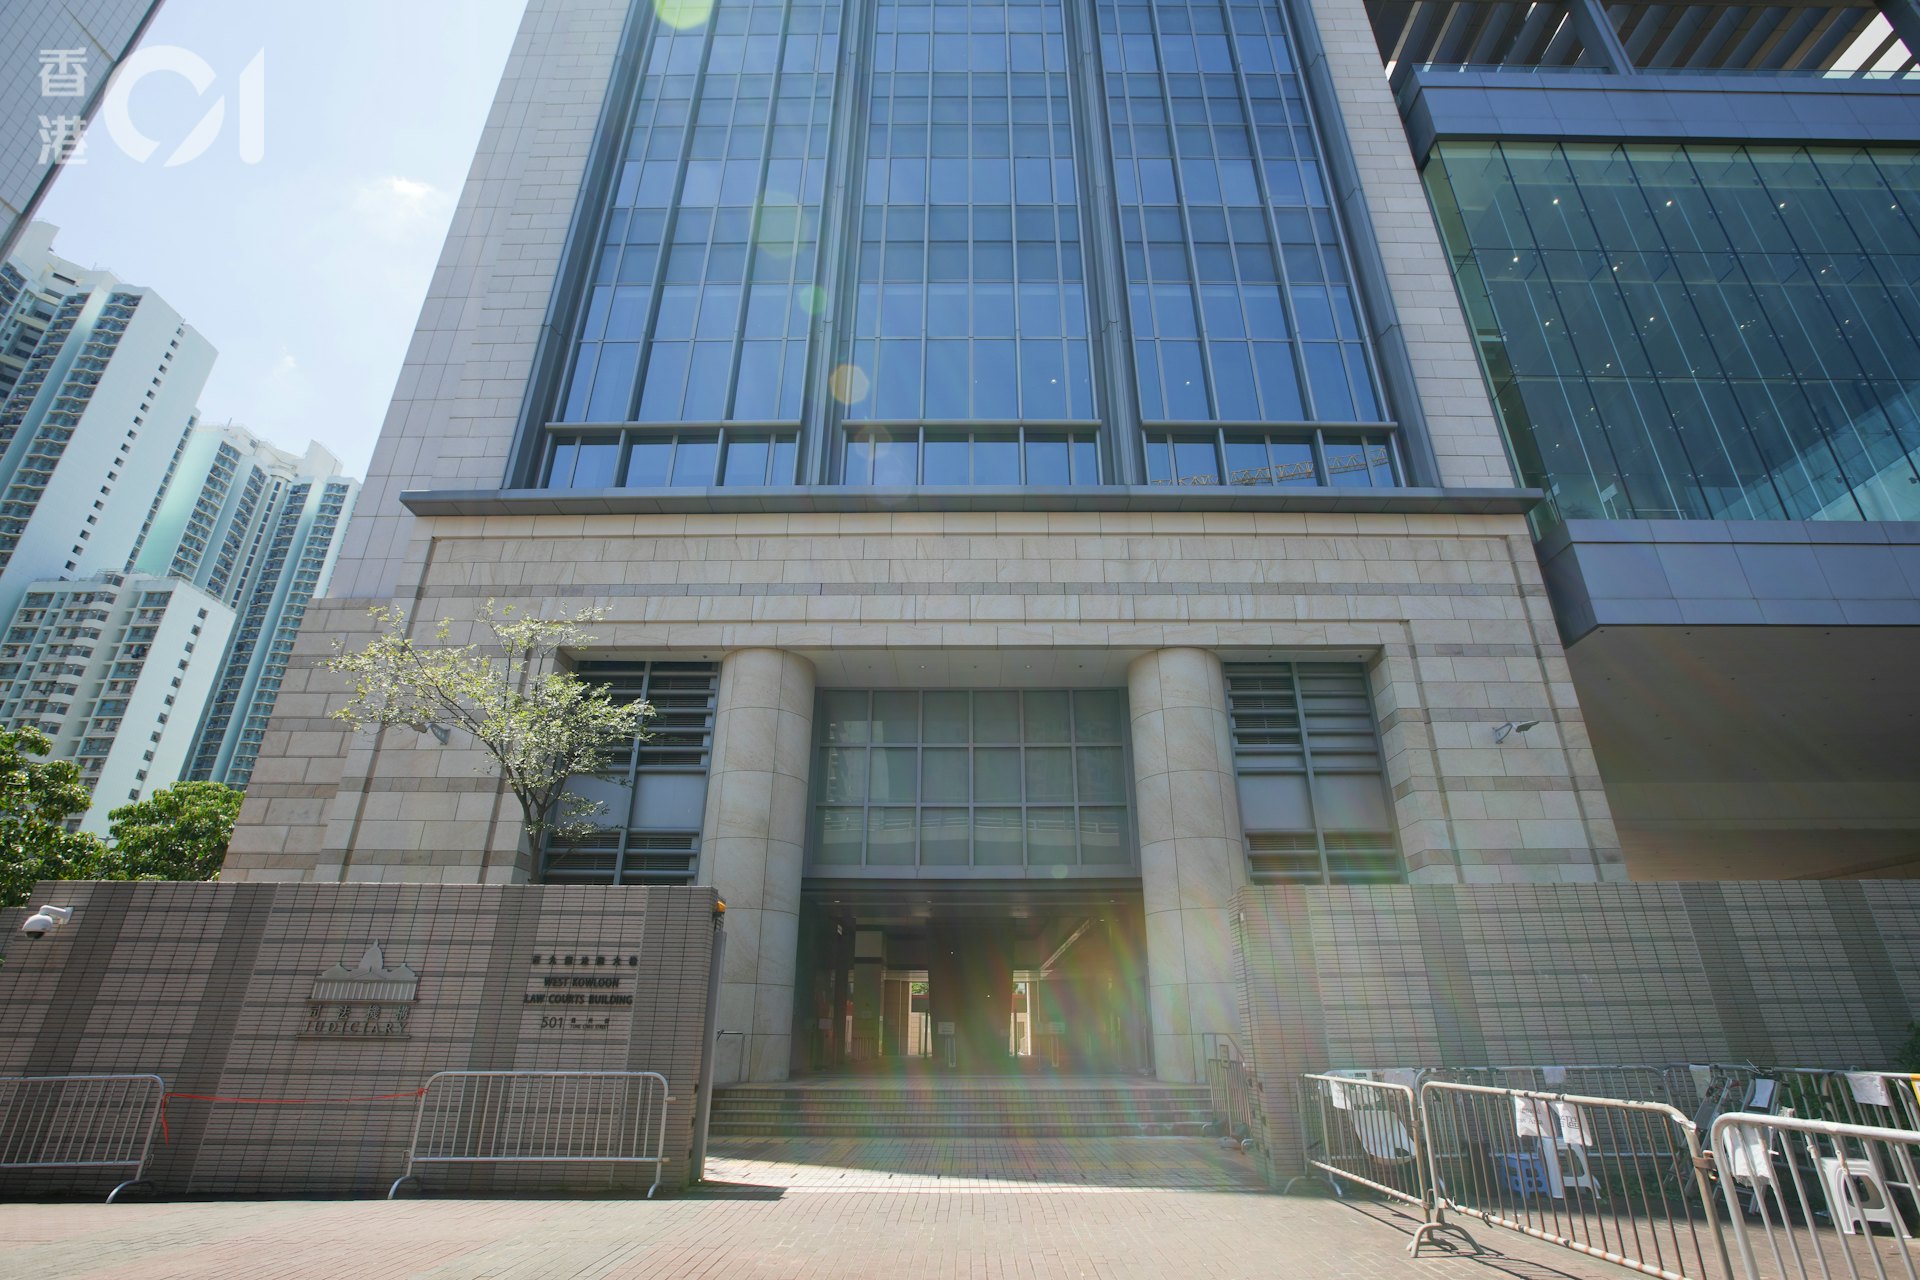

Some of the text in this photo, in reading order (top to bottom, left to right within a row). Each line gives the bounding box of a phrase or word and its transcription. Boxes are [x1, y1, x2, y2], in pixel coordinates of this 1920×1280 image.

[544, 977, 620, 988] WEST KOWLOON
[523, 993, 633, 1005] LAW COURTS BUILDING
[310, 1004, 410, 1021] 司法機構
[304, 1021, 409, 1034] JUDICIARY
[541, 1016, 563, 1028] 501
